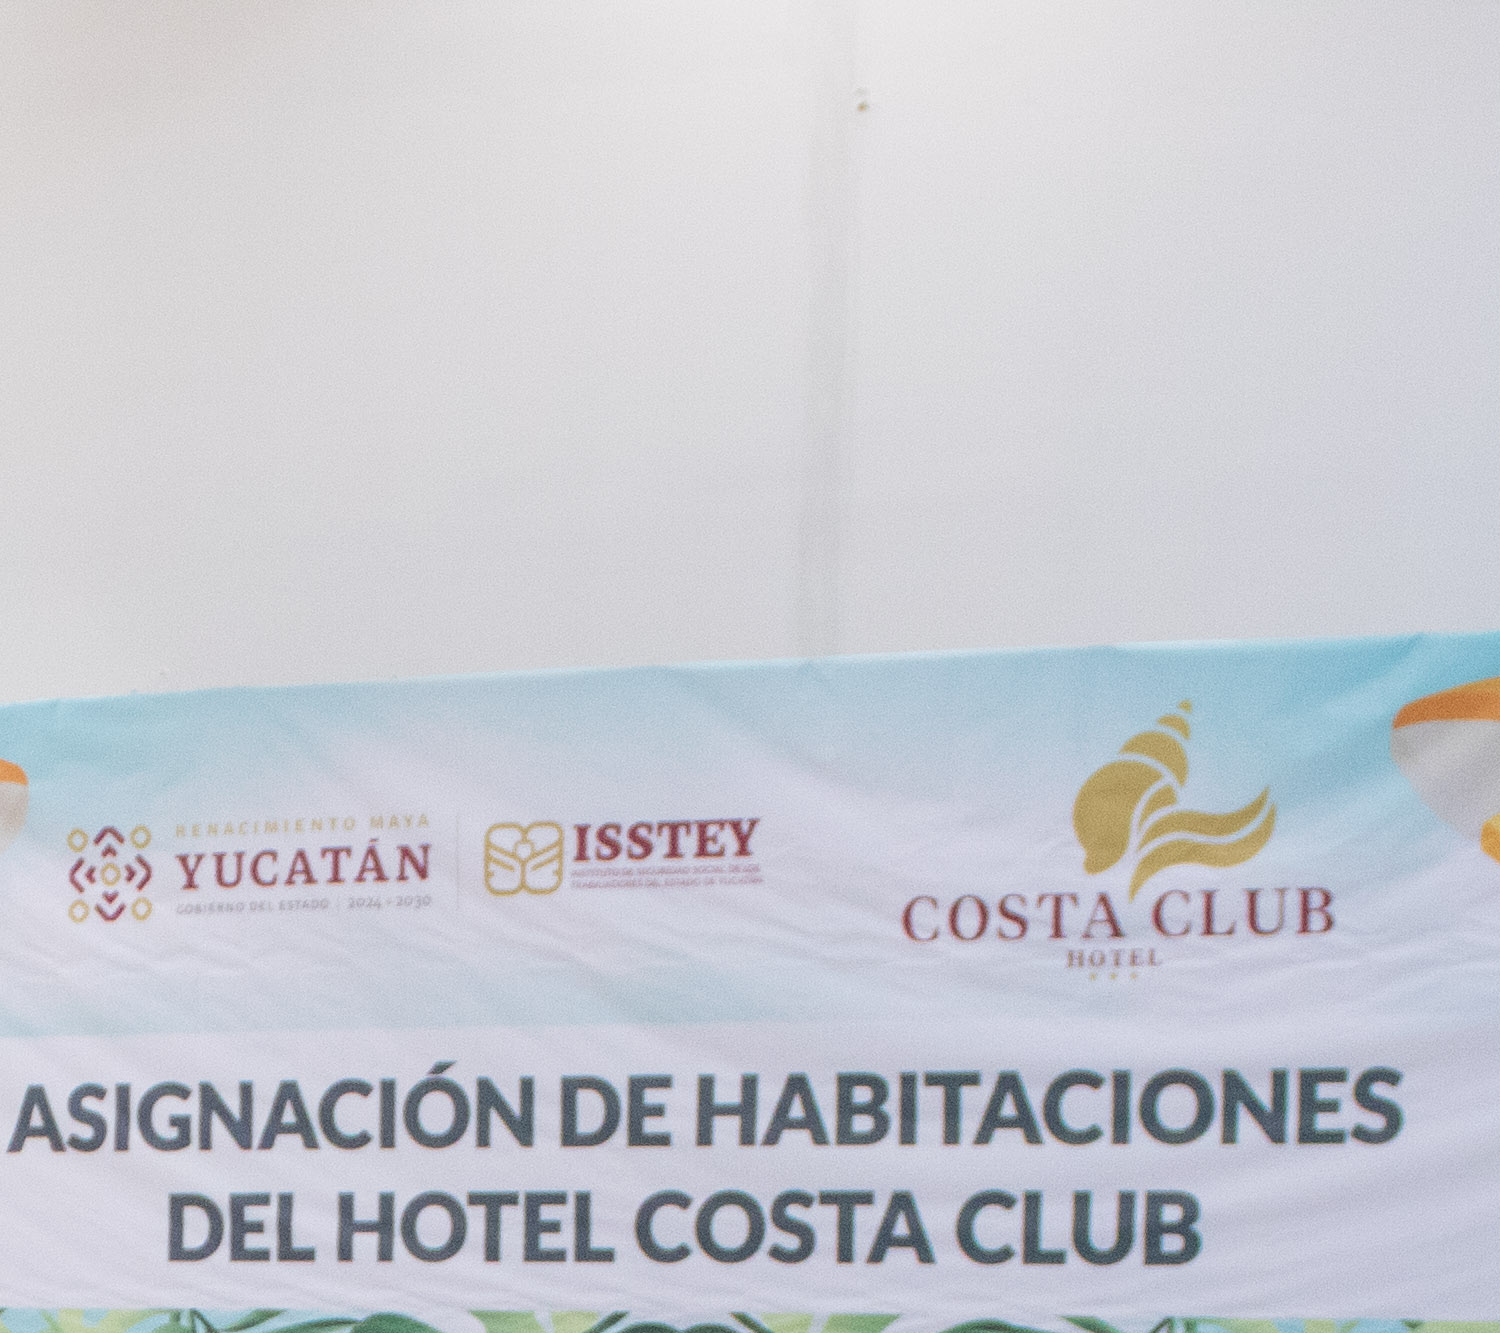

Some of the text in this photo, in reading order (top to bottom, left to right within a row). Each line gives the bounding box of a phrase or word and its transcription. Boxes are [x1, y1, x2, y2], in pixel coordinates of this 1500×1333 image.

[175, 813, 430, 838] RENACIMIENTO MAYA
[573, 817, 760, 862] ISSTEY
[174, 838, 432, 891] YUCATÁN
[901, 886, 1335, 942] COSTA CLUB
[1066, 947, 1162, 969] HOTEL
[6, 1061, 1404, 1152] ASIGNACIÓN DE HABITACIONES
[168, 1187, 1202, 1266] DEL HOTEL COSTA CLUB
